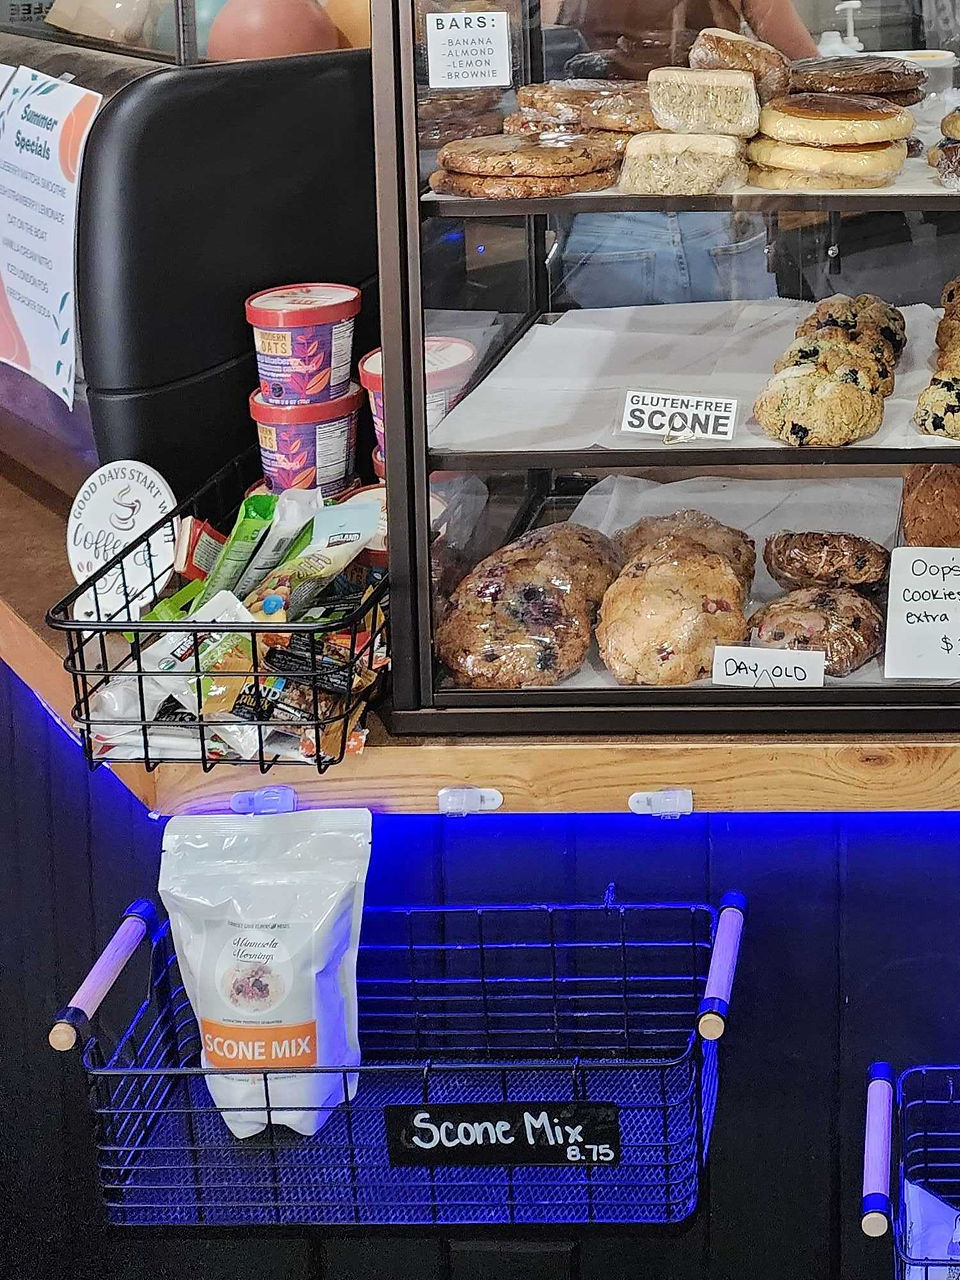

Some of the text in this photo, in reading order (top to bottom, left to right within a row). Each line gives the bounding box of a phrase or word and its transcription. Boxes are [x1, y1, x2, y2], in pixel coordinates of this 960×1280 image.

[435, 16, 497, 30] BARS:
[20, 103, 58, 132] Summer
[14, 130, 51, 161] Specials
[261, 343, 287, 354] OATS
[630, 395, 733, 413] GLUTEN-FREE
[627, 408, 729, 436] SCONE
[73, 467, 162, 519] GOOD DAYS START
[906, 611, 950, 625] extra
[724, 659, 807, 681] DAY OLD
[204, 1033, 311, 1060] SCONE MIX
[411, 1111, 584, 1149] Scone Mix
[566, 1144, 615, 1161] 8.75
